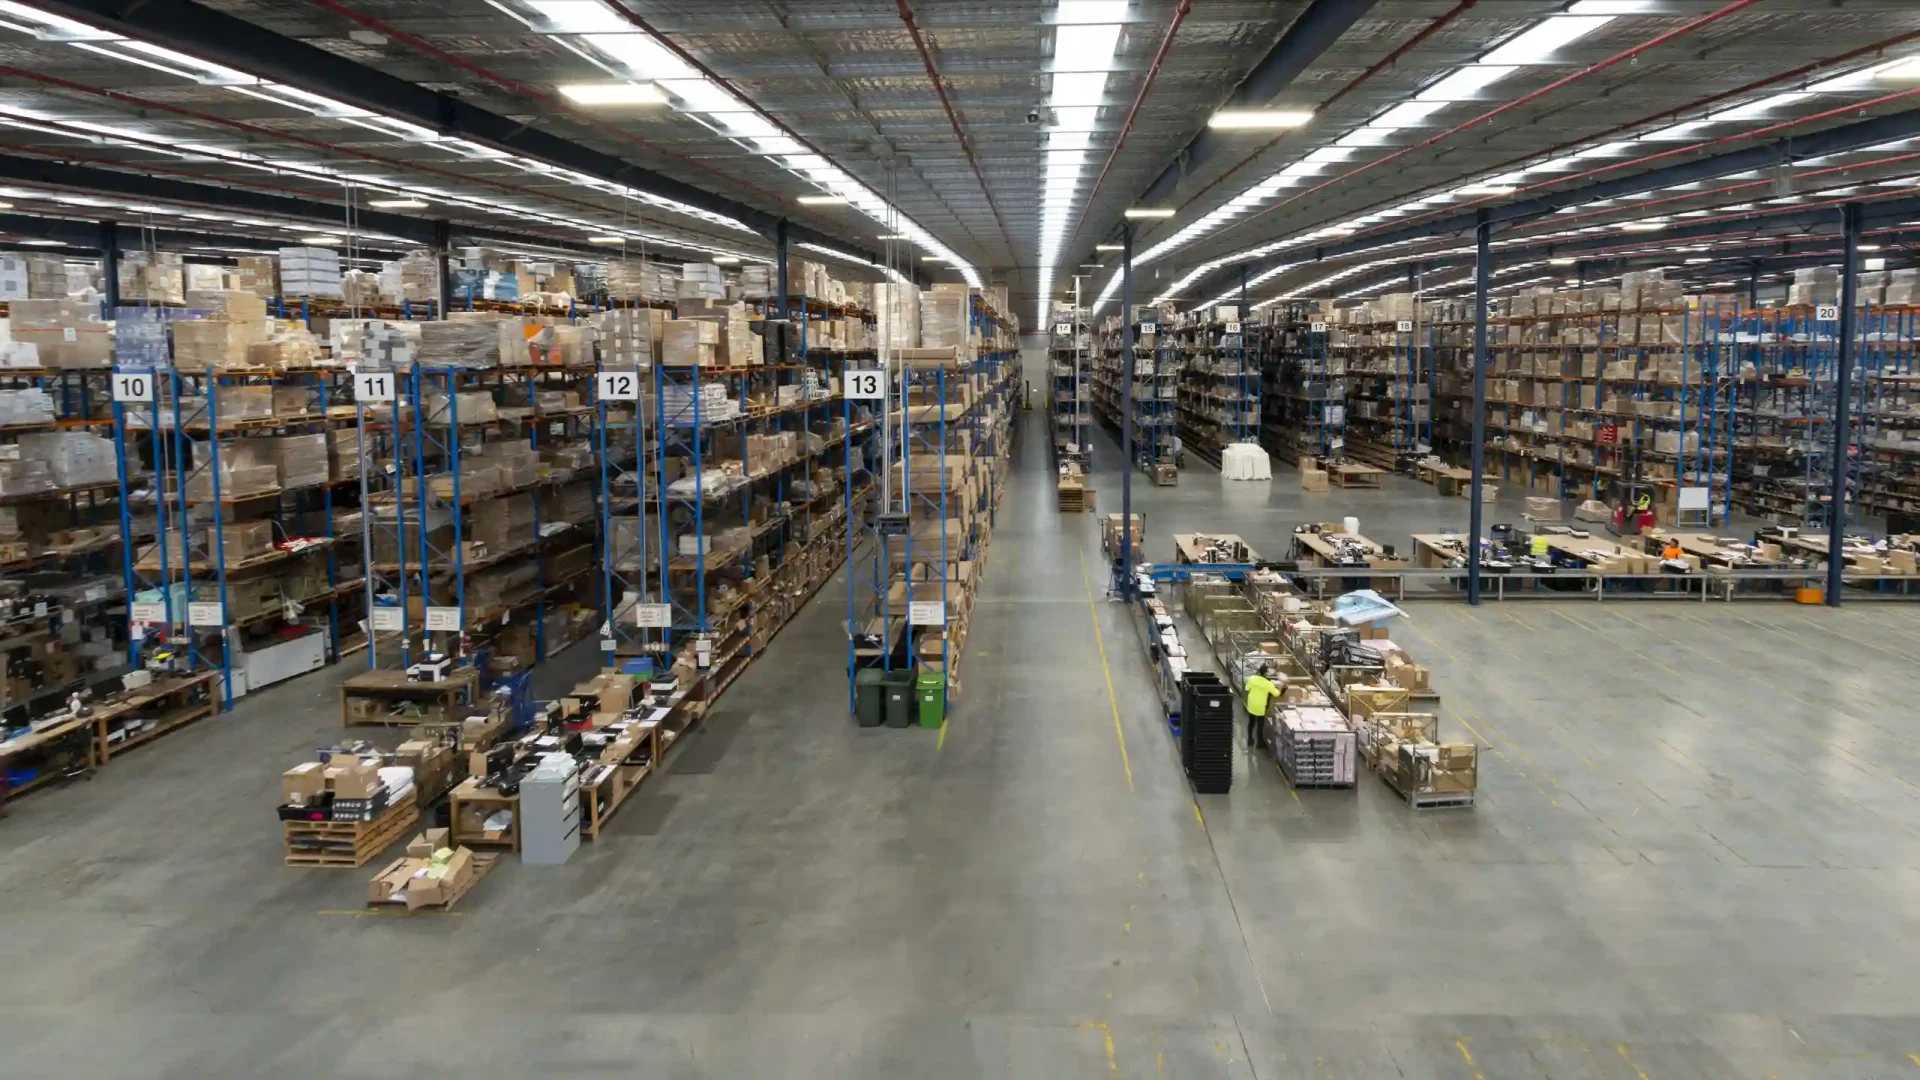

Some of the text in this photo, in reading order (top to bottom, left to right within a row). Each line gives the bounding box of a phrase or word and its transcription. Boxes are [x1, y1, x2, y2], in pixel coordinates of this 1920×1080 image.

[1820, 308, 1835, 318] 20
[1142, 324, 1153, 332] 15
[1229, 324, 1238, 332] 16
[1314, 323, 1324, 331] 17
[1400, 322, 1410, 330] 18
[120, 378, 145, 397] 10
[364, 377, 385, 397] 11
[606, 376, 631, 395] 12
[852, 375, 877, 395] 13
